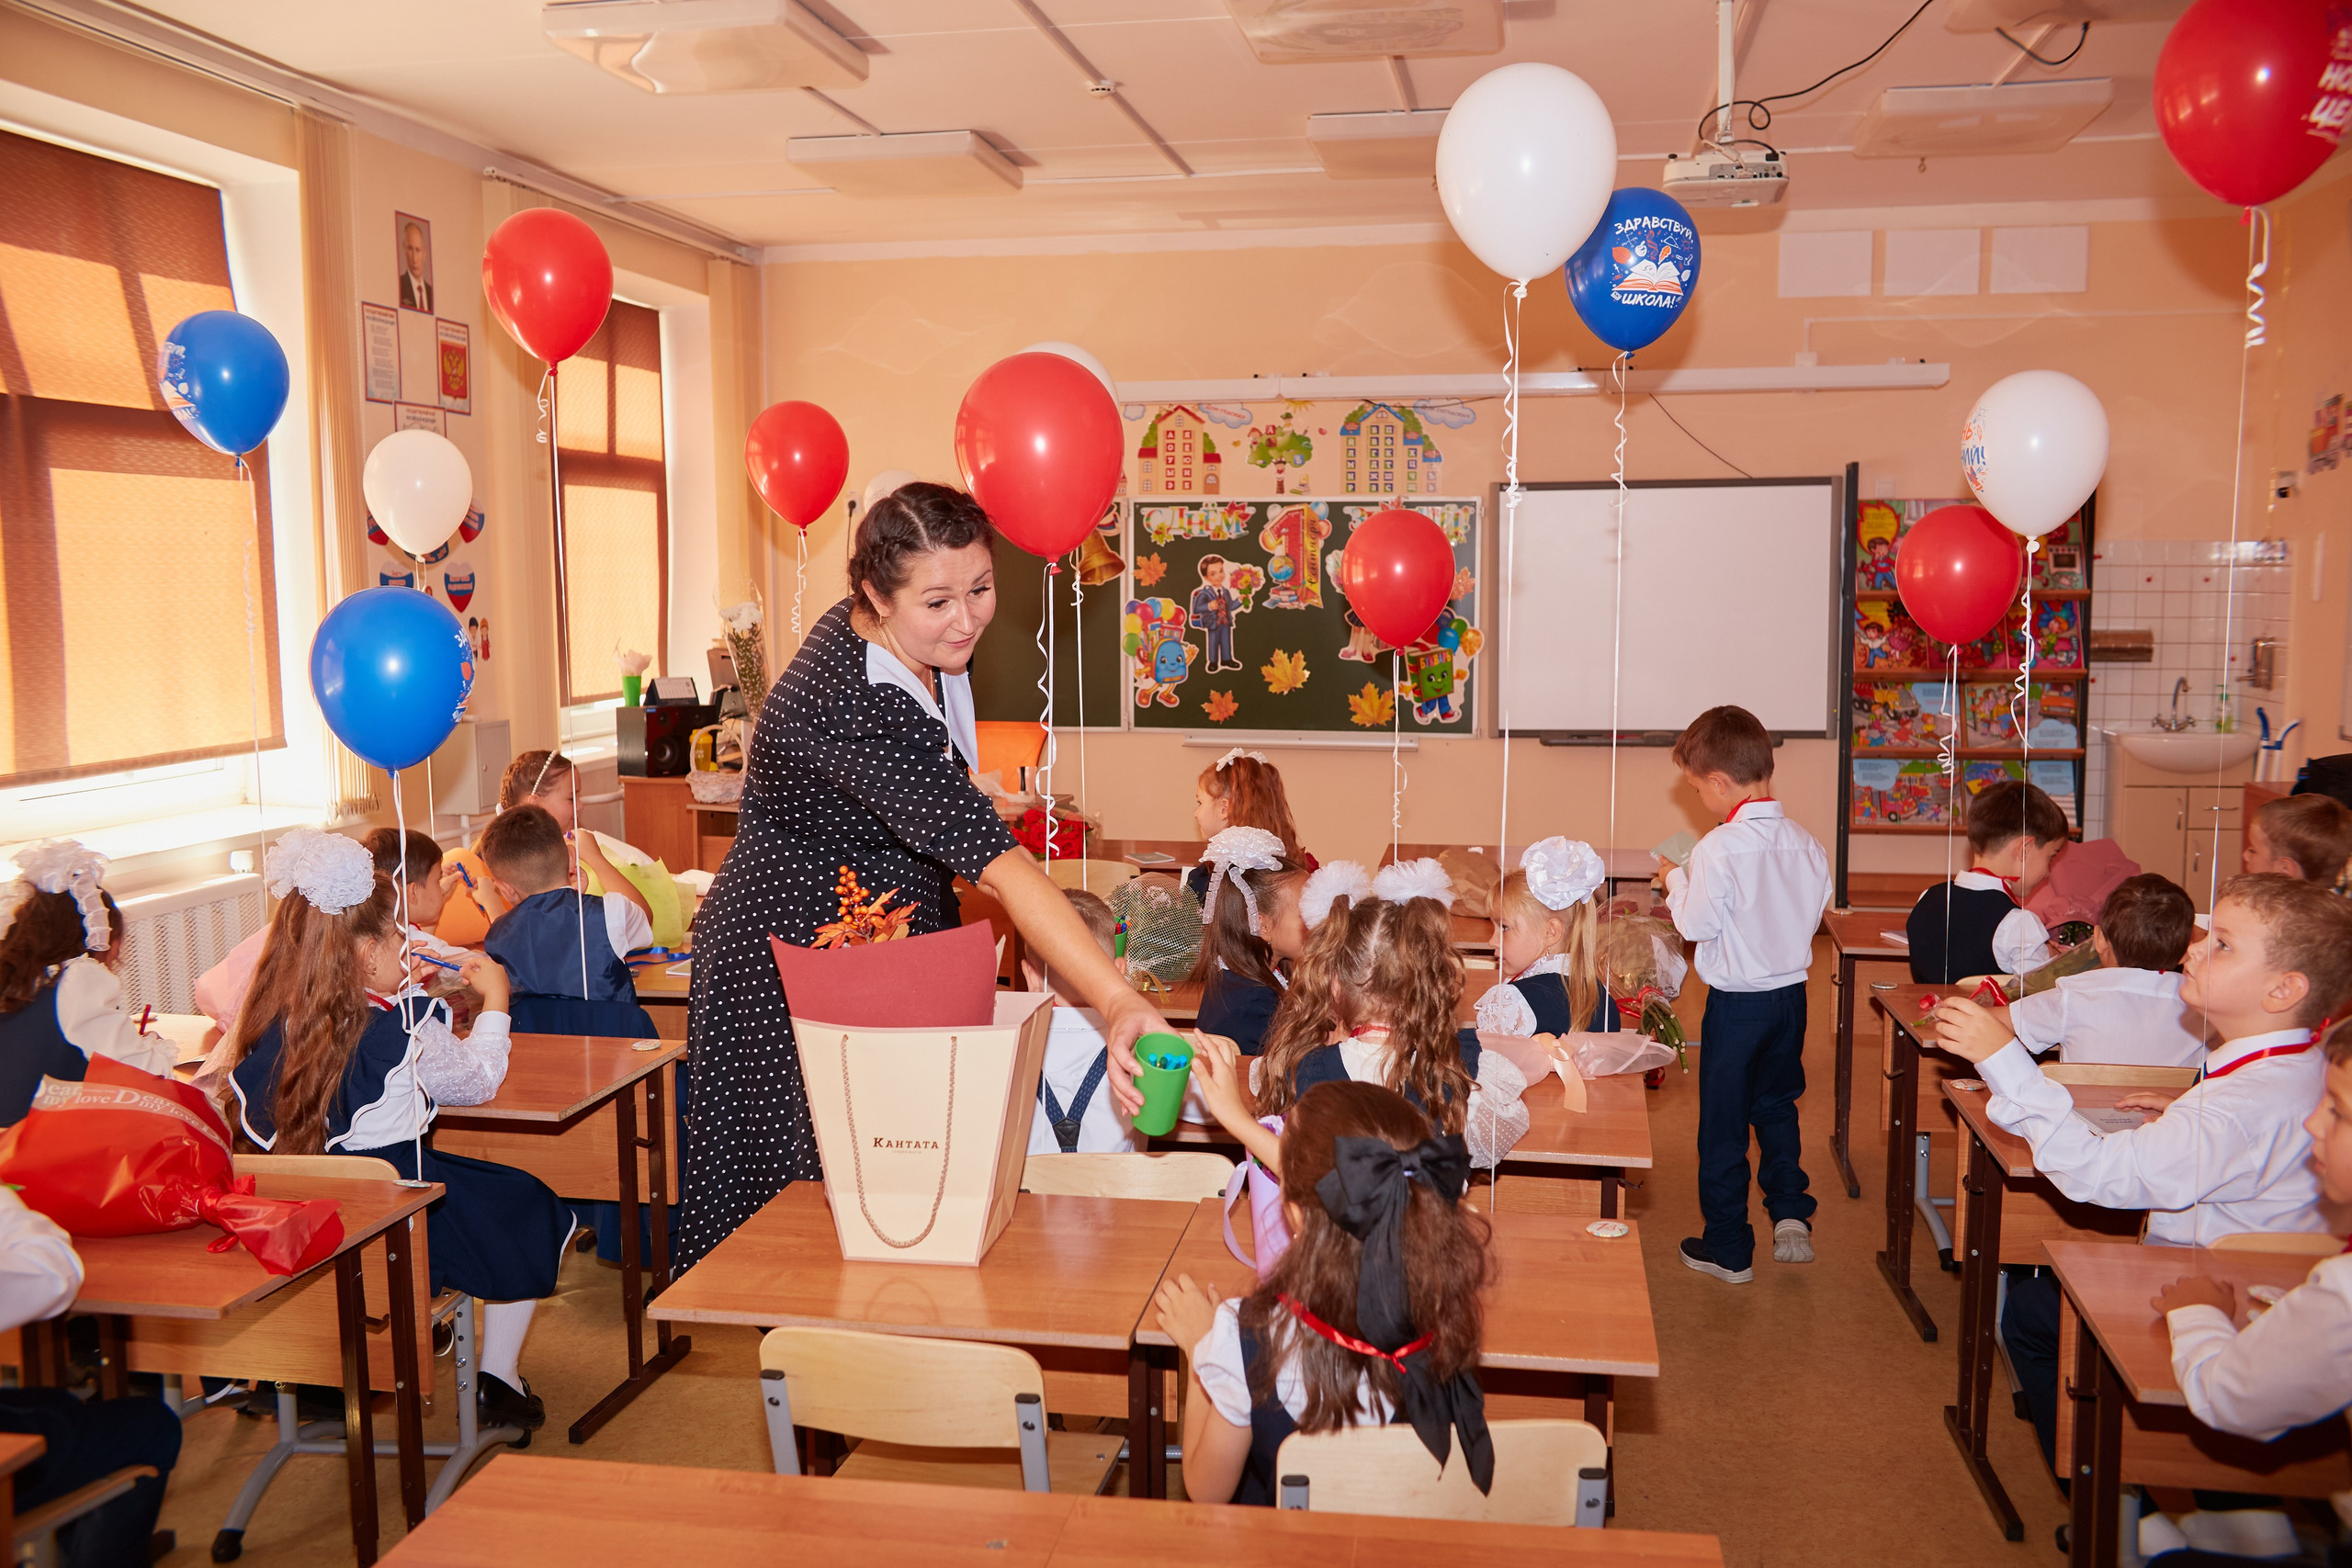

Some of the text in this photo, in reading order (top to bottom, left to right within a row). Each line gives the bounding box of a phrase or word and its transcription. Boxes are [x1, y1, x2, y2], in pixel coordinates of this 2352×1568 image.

[1622, 293, 1676, 309] ШКОЛА!
[1419, 650, 1452, 670] БУКВАРЬ
[74, 1092, 111, 1104] love
[139, 1100, 165, 1112] my
